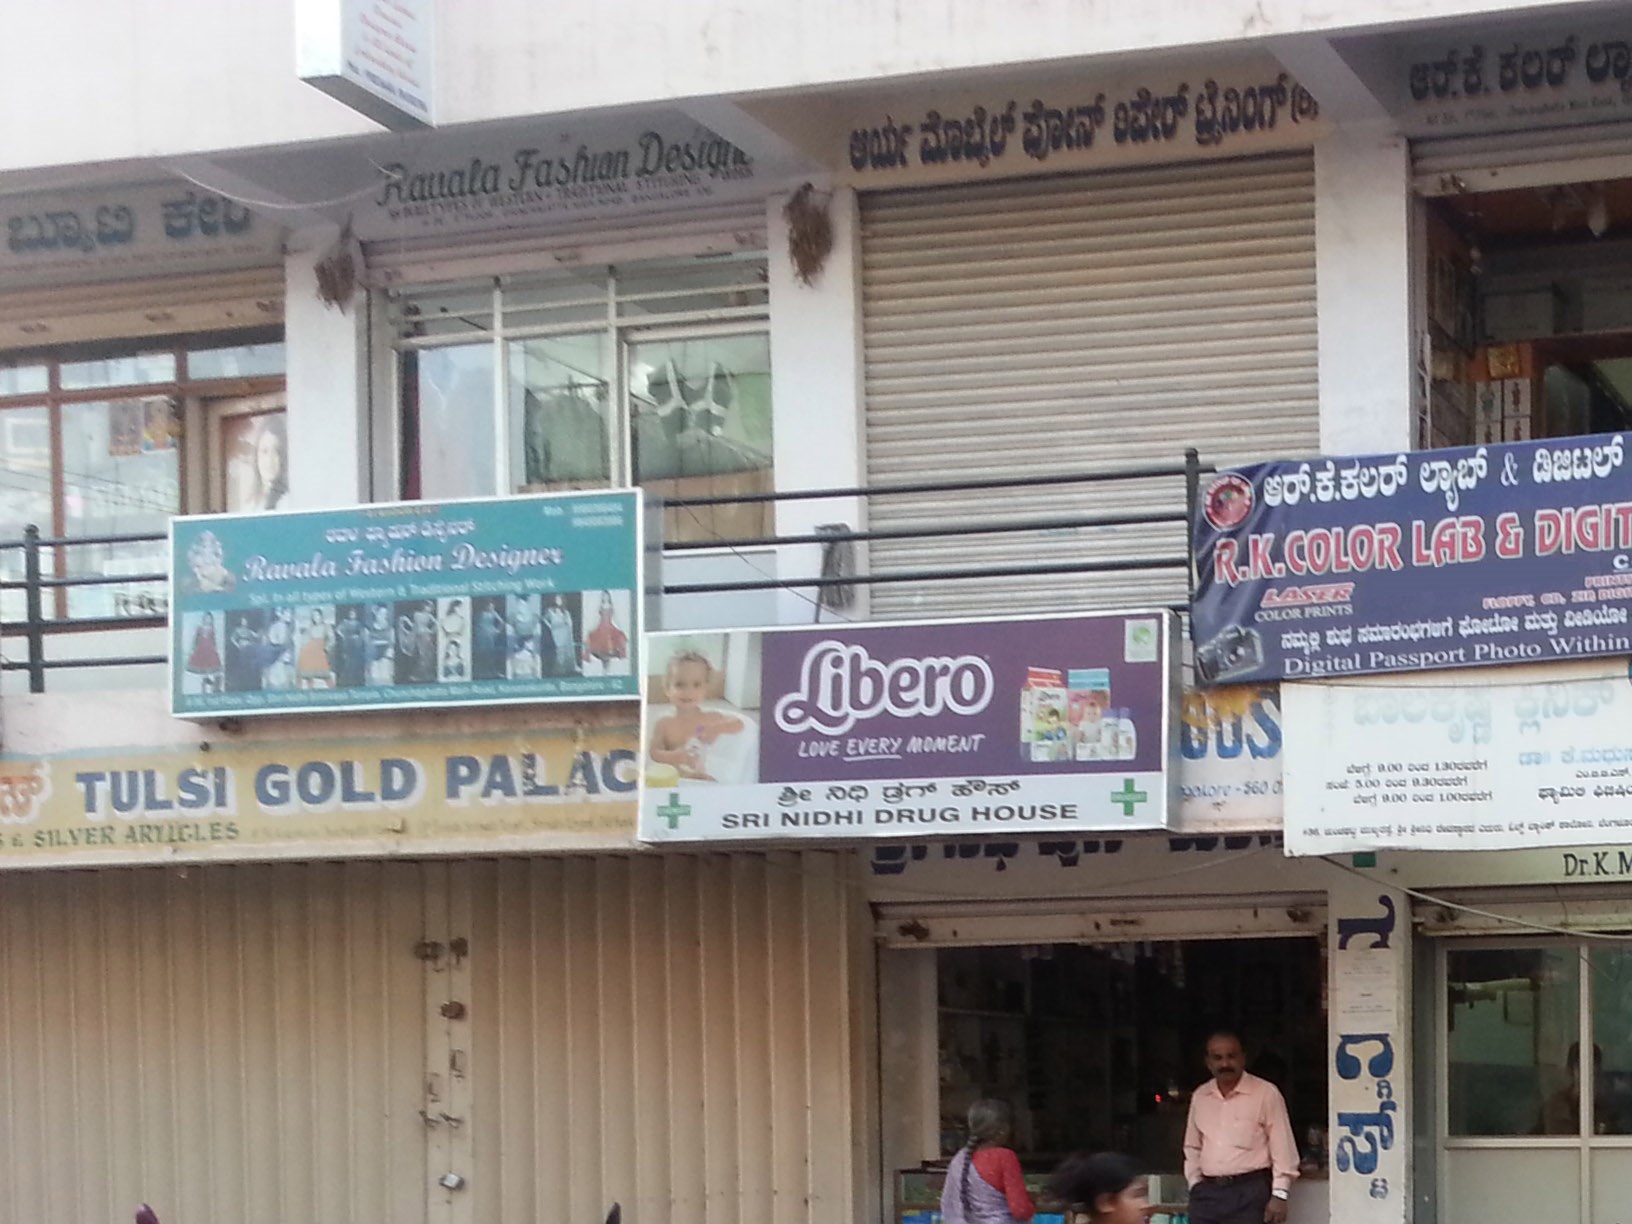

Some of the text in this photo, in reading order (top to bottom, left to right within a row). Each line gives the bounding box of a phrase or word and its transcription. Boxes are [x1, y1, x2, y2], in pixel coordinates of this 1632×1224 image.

[1419, 447, 1489, 512] ಲ್ಯಾಬ್
[1501, 452, 1519, 487] &
[1533, 434, 1624, 484] ಡಿಜಿಟಲ್
[1412, 515, 1486, 568] LAB
[1495, 512, 1524, 559] &
[242, 542, 563, 582] Ravala Fashion Designer
[1260, 582, 1355, 607] LASER
[1254, 604, 1353, 623] COLOR PRINTS
[1284, 653, 1361, 676] Digital
[1369, 644, 1464, 672] Passport
[1474, 639, 1541, 661] Photo
[1550, 629, 1631, 655] Within
[775, 640, 994, 736] Libero
[798, 734, 986, 757] LOVE EVERY MOMENT
[76, 766, 230, 815] TULSI
[255, 758, 421, 808] GOLD
[776, 785, 812, 806] ಶ್ರೀ
[825, 782, 868, 802] ನಿಧಿ
[950, 779, 1022, 798] ಹೌಸ್
[721, 804, 1078, 829] SRI NIDHI DRUG HOUSE
[33, 824, 116, 848] SILVER
[124, 821, 239, 844] ARTICLES
